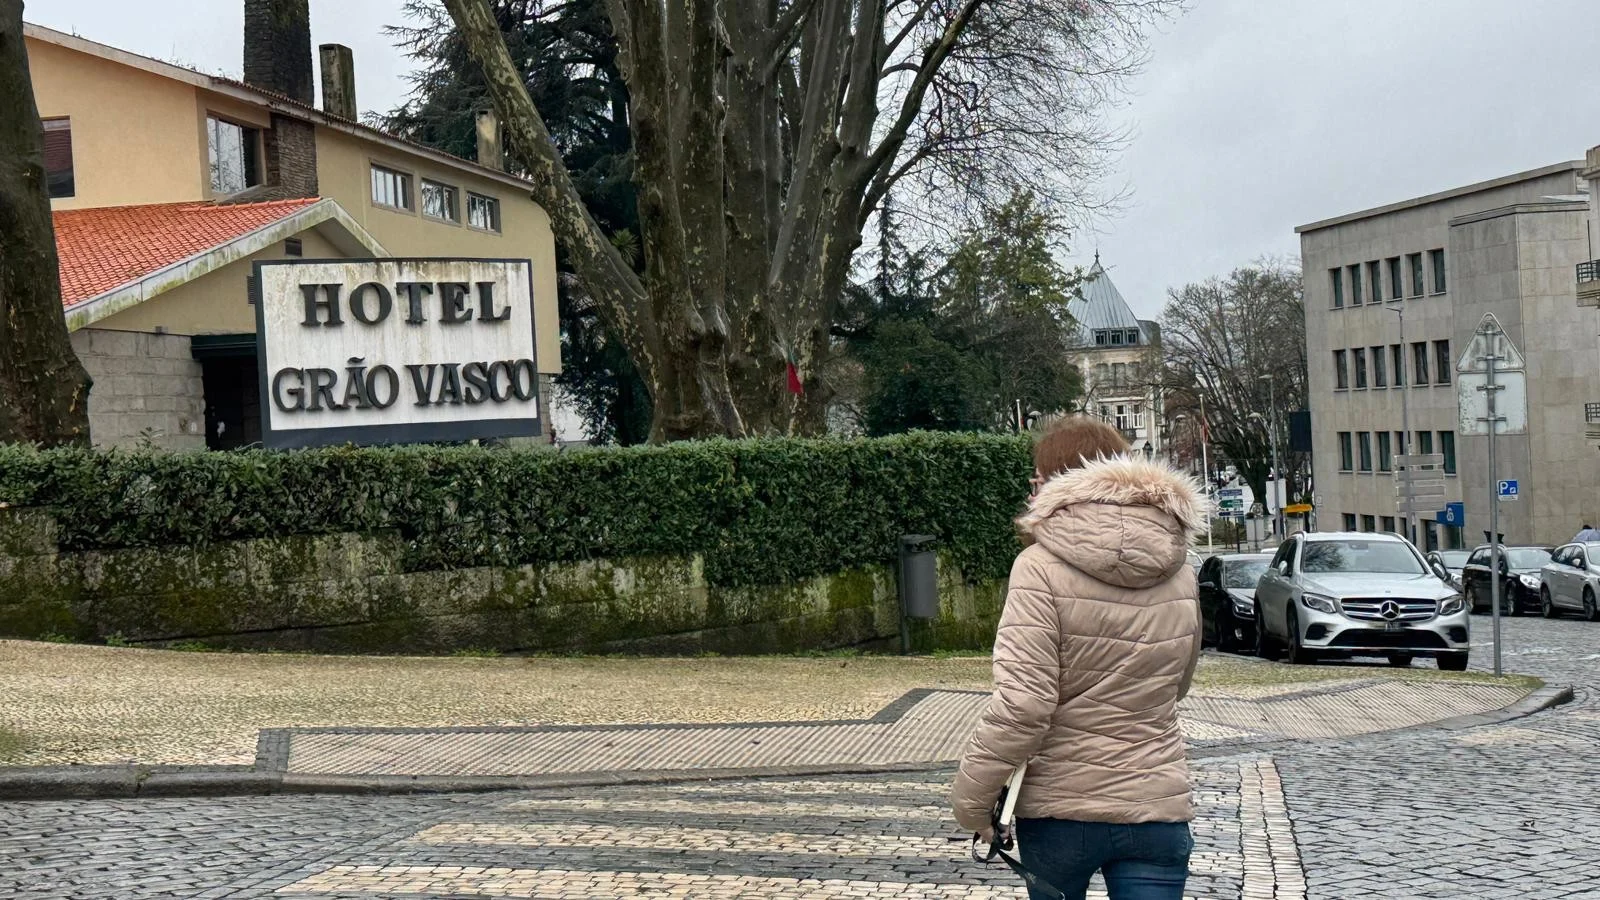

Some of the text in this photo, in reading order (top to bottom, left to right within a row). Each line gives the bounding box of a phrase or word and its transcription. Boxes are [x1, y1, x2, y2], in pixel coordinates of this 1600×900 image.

[300, 282, 511, 325] HOTEL
[272, 357, 538, 412] GRÃO VASCO
[1500, 481, 1508, 494] P
